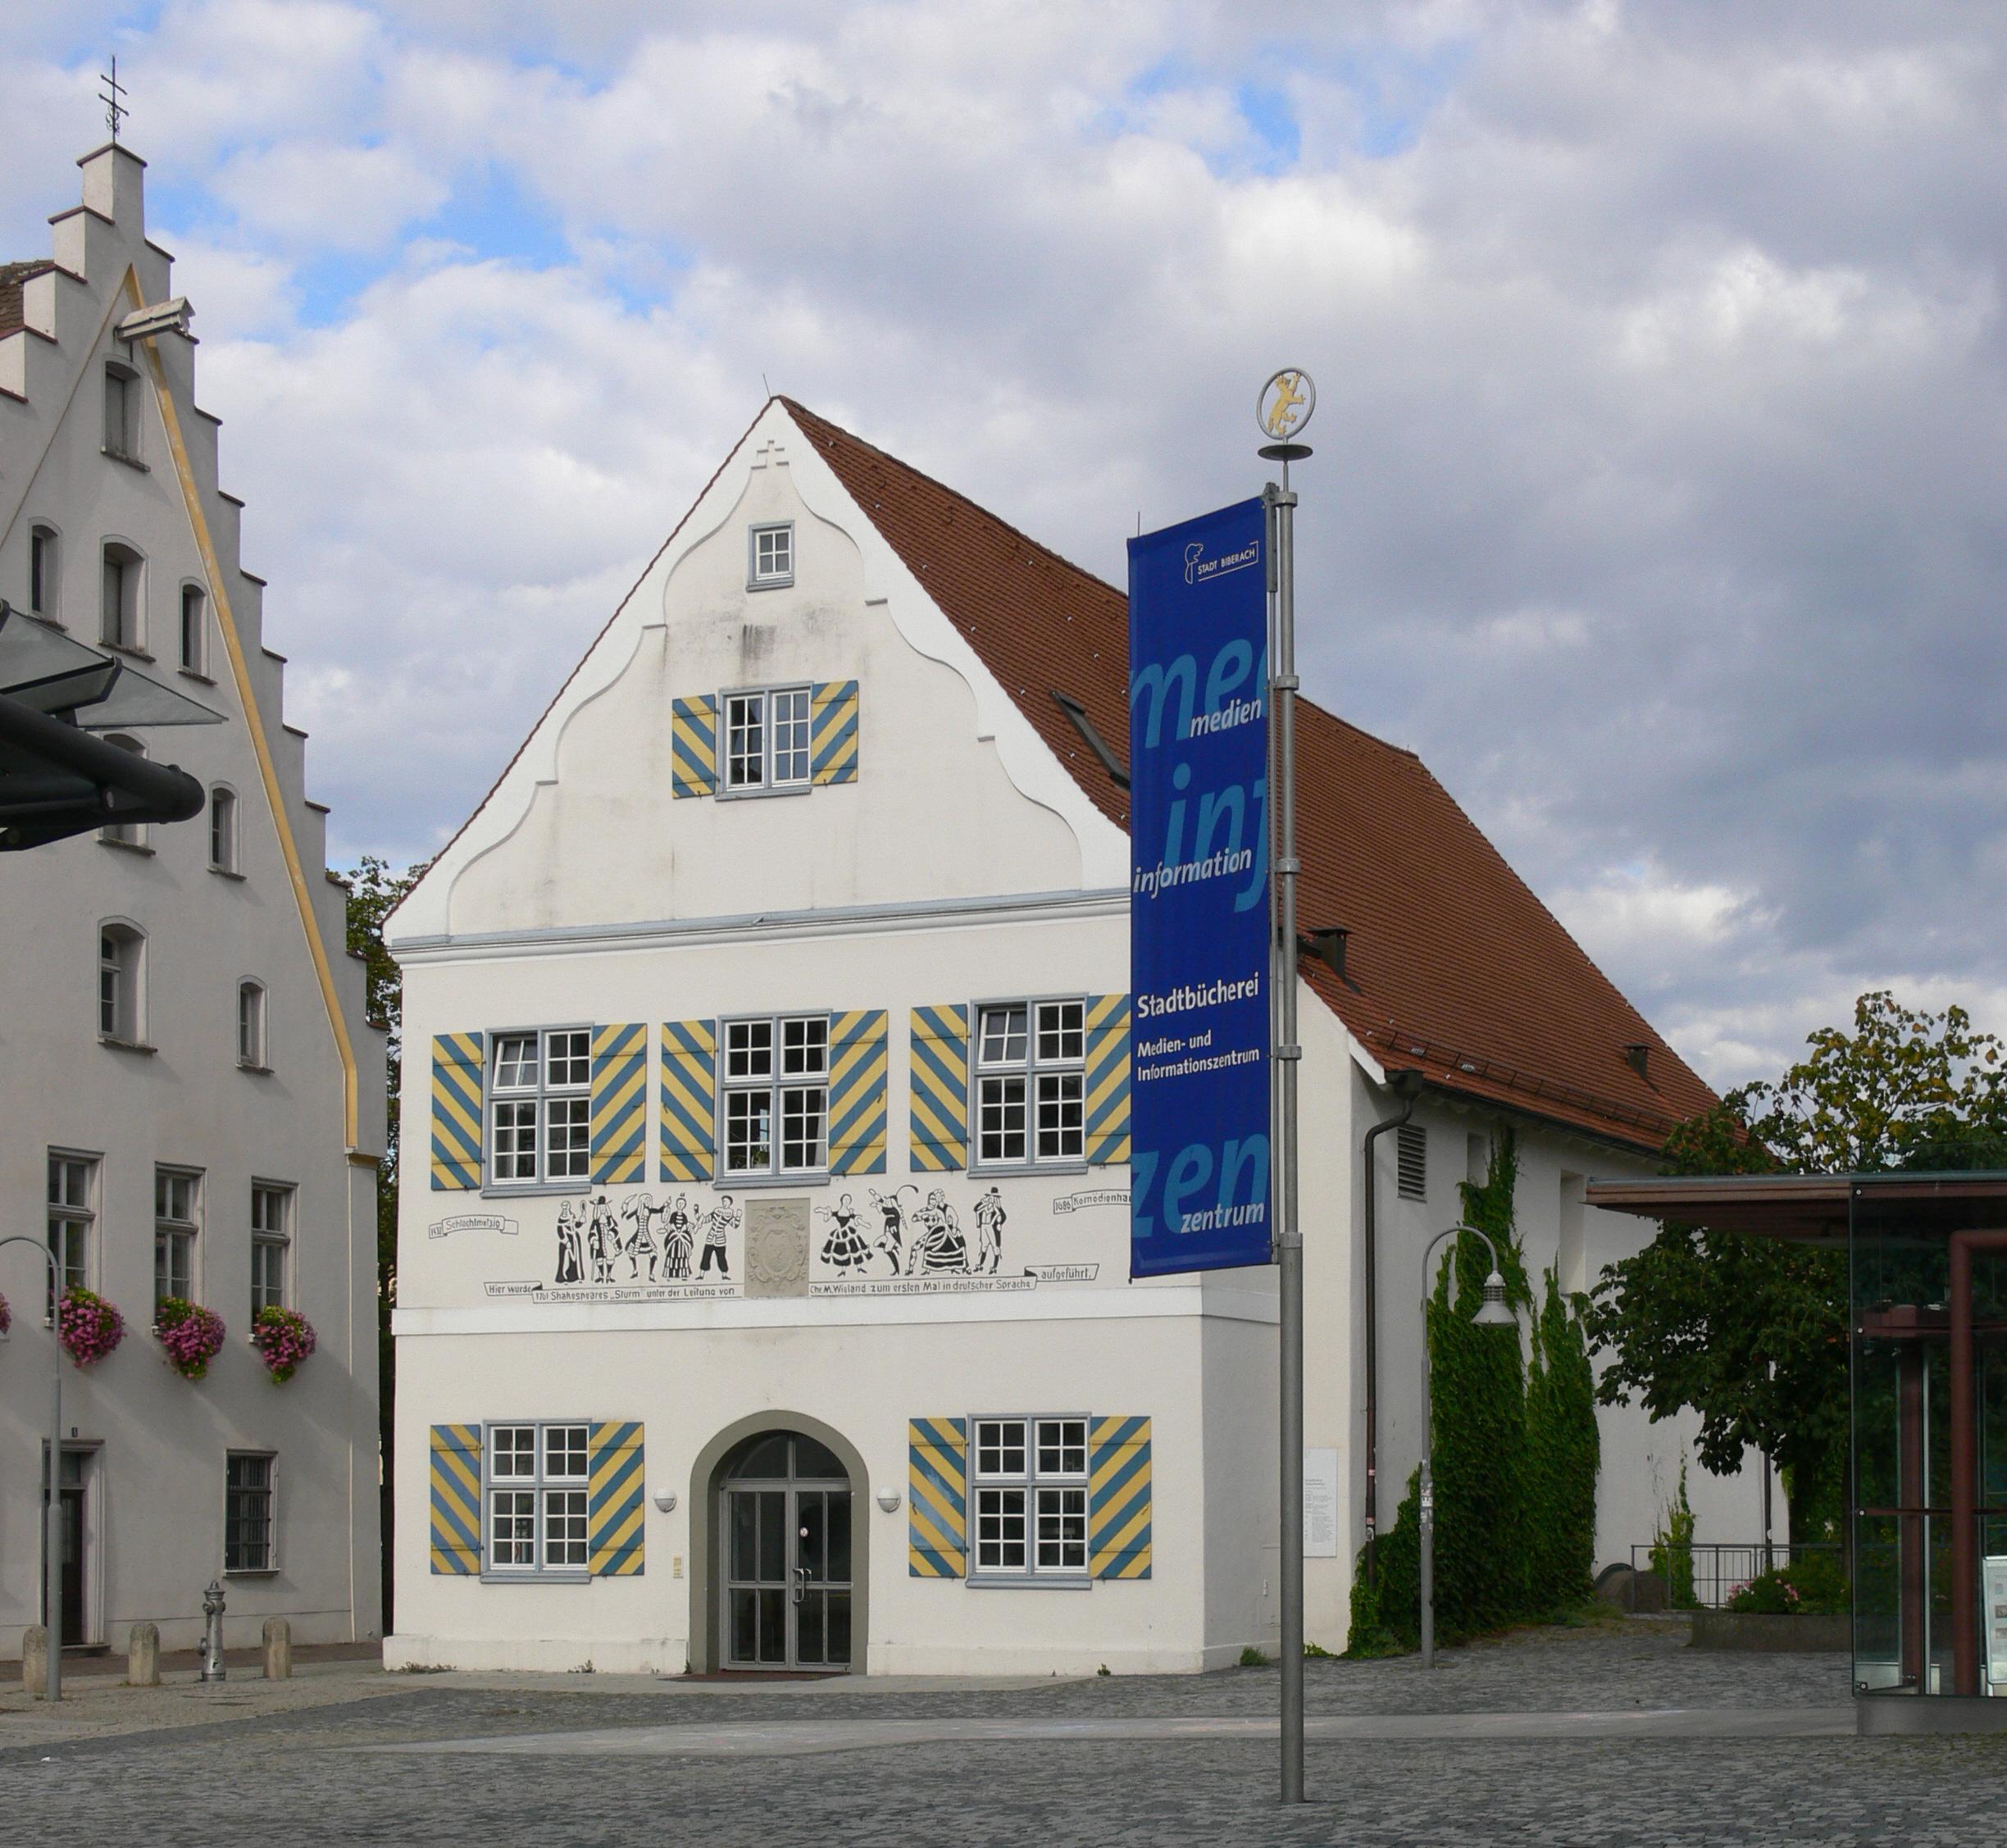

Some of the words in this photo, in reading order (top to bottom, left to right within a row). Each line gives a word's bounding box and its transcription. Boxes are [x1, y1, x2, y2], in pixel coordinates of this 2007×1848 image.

[1198, 560, 1217, 575] STADT
[1221, 548, 1255, 567] BIBERACH
[1190, 698, 1262, 738] medien
[1133, 848, 1252, 899] information
[1137, 972, 1259, 1018] Stadtbücherei
[1137, 1036, 1186, 1058] Medien-
[1189, 1029, 1212, 1049] und
[1137, 1048, 1259, 1081] Informationszentrum
[1181, 1202, 1264, 1234] zentrum
[489, 1285, 505, 1294] Hier
[551, 1291, 608, 1301] Shakespeares
[647, 1289, 665, 1298] unter
[667, 1288, 680, 1297] der
[684, 1287, 716, 1297] Leitung
[719, 1287, 735, 1295] von
[871, 1285, 890, 1293] zum
[894, 1284, 920, 1293] ersten
[923, 1281, 940, 1290] Mal
[943, 1281, 951, 1290] in
[953, 1280, 993, 1290] deutscher
[996, 1279, 1031, 1290] Sprache
